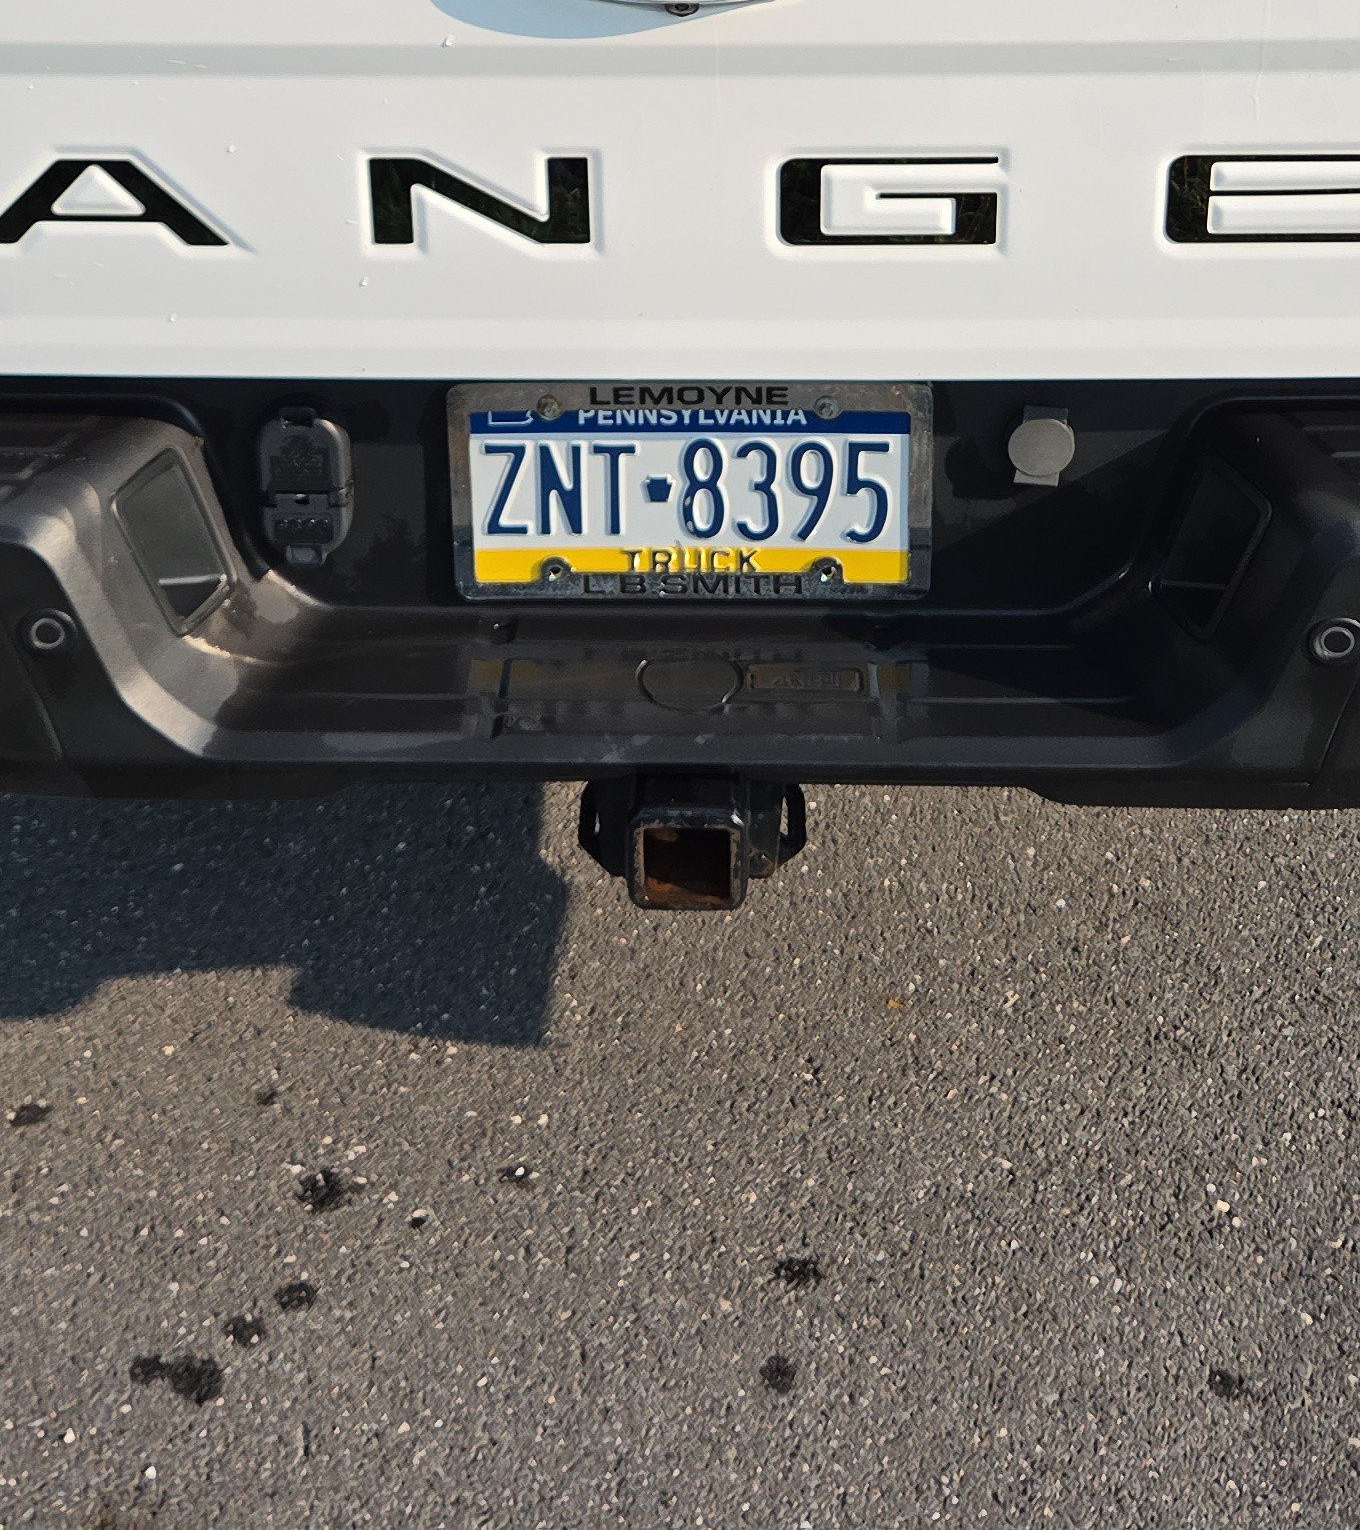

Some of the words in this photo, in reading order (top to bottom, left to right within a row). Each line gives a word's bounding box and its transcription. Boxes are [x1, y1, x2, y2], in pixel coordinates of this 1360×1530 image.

[588, 386, 790, 406] LEMOYNE
[578, 409, 808, 426] PENNSYLVANIA
[620, 547, 762, 573] TRUCK
[660, 574, 803, 596] SMITH
